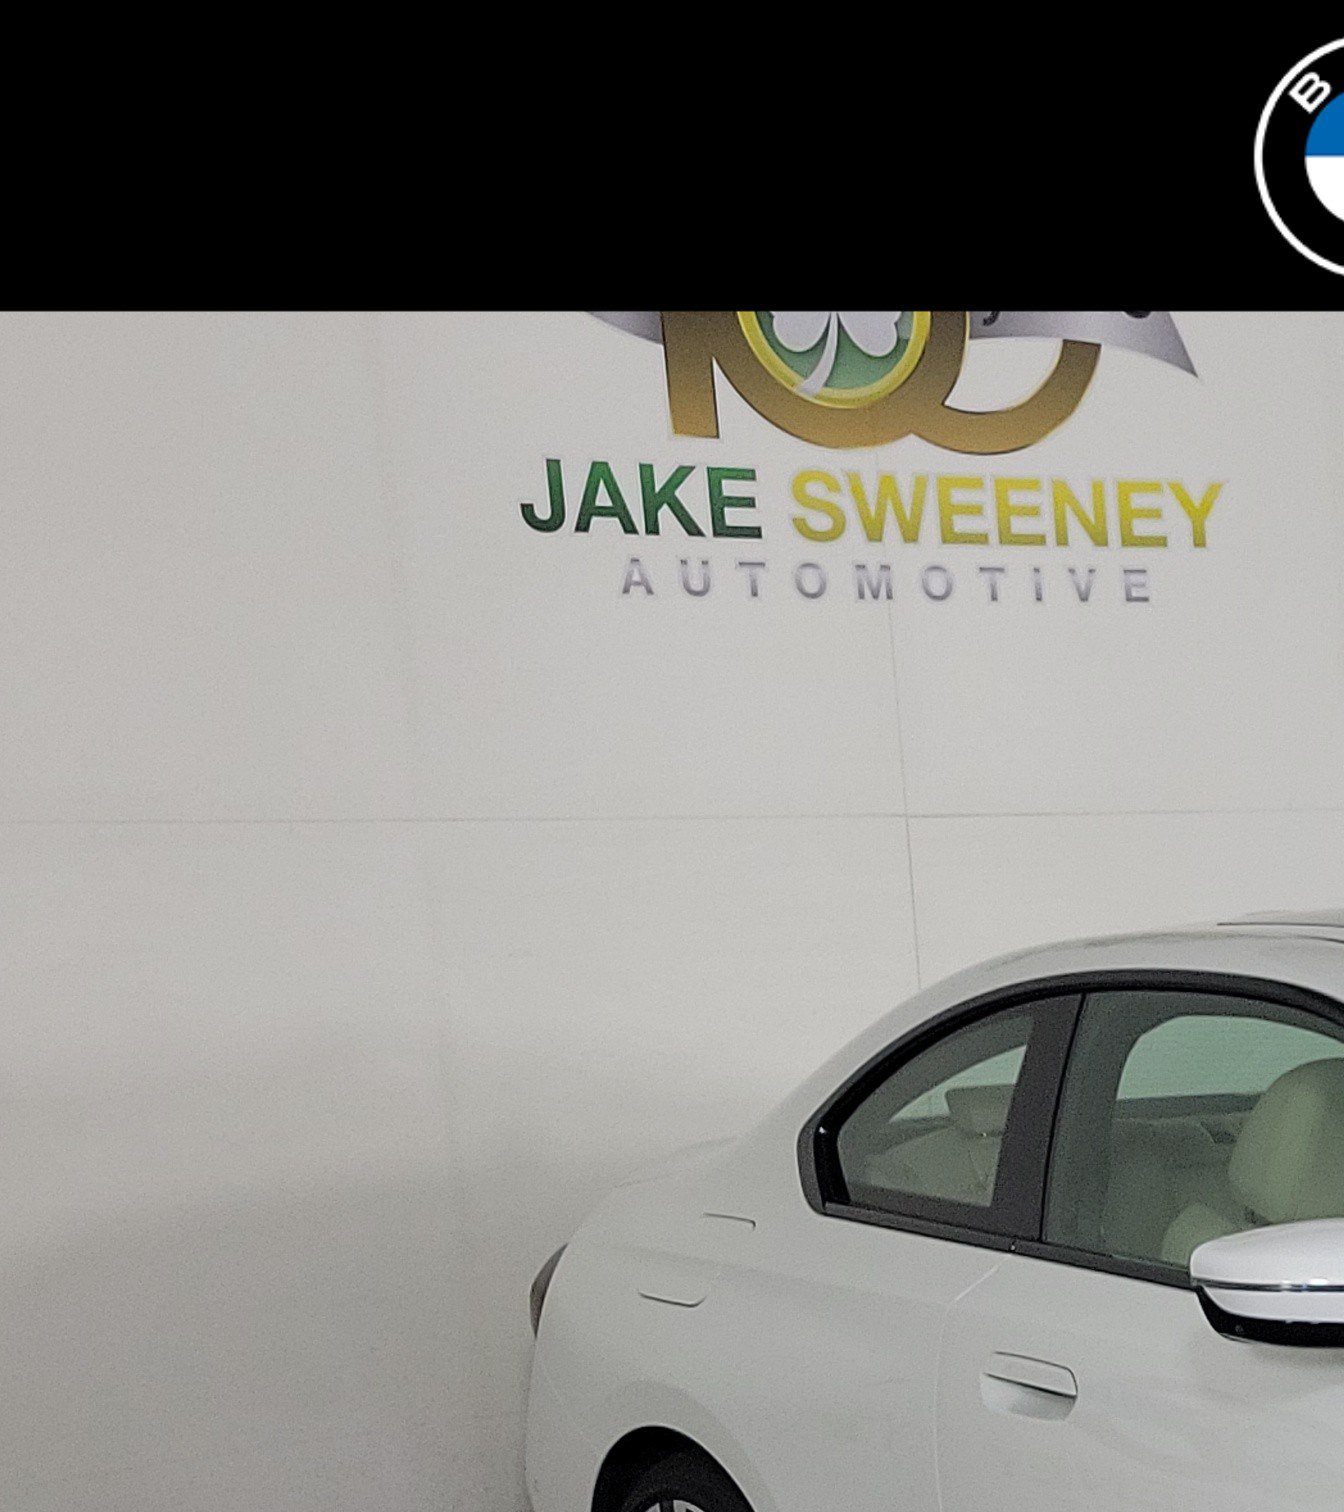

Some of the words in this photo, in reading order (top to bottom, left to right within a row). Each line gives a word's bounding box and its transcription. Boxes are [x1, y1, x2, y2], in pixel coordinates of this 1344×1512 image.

[520, 458, 764, 540] JAKE
[791, 470, 1223, 548] SWEENEY
[621, 557, 1151, 602] AUTOMOTIVE
